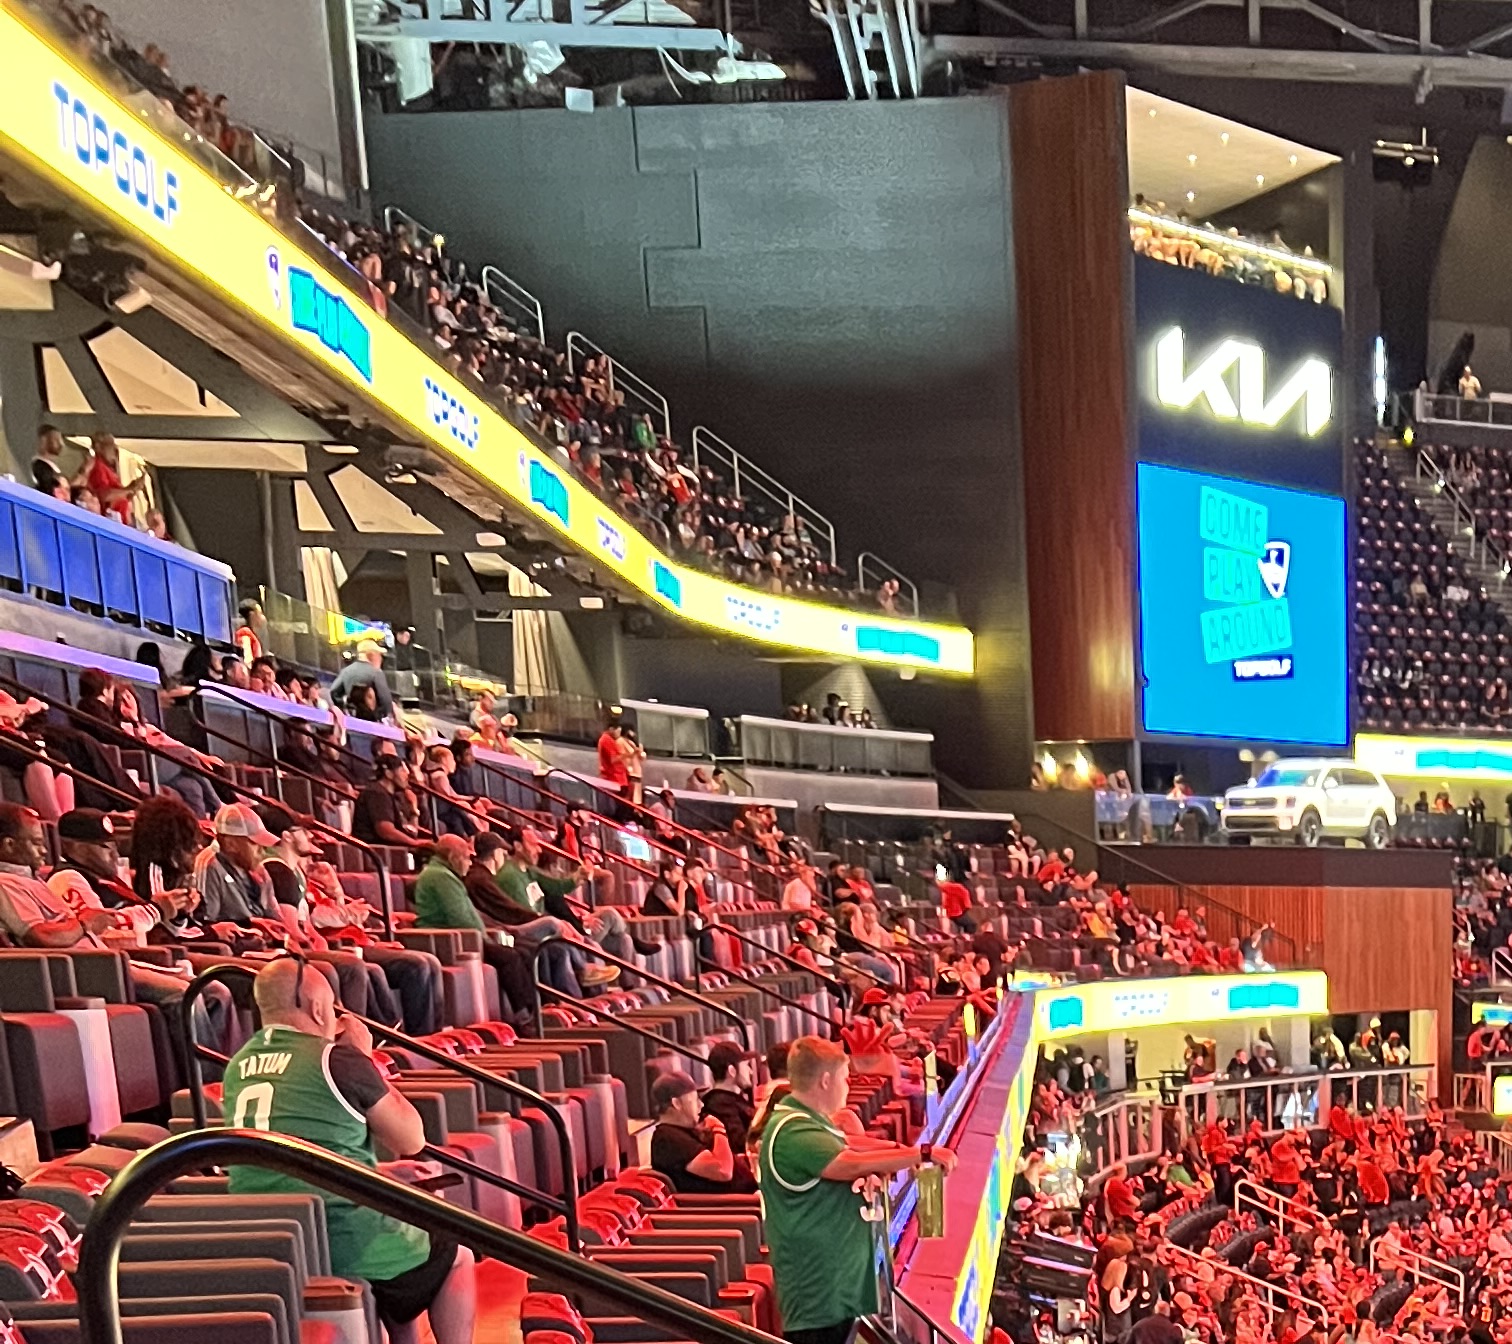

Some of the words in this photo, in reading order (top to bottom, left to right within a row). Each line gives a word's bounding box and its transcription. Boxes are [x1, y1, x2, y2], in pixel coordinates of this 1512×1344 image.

[54, 82, 177, 224] TOPGOLF
[1204, 493, 1265, 552] COME
[1208, 553, 1258, 598] PLAY
[1207, 604, 1289, 657] AROUND
[238, 1052, 293, 1080] TATUM
